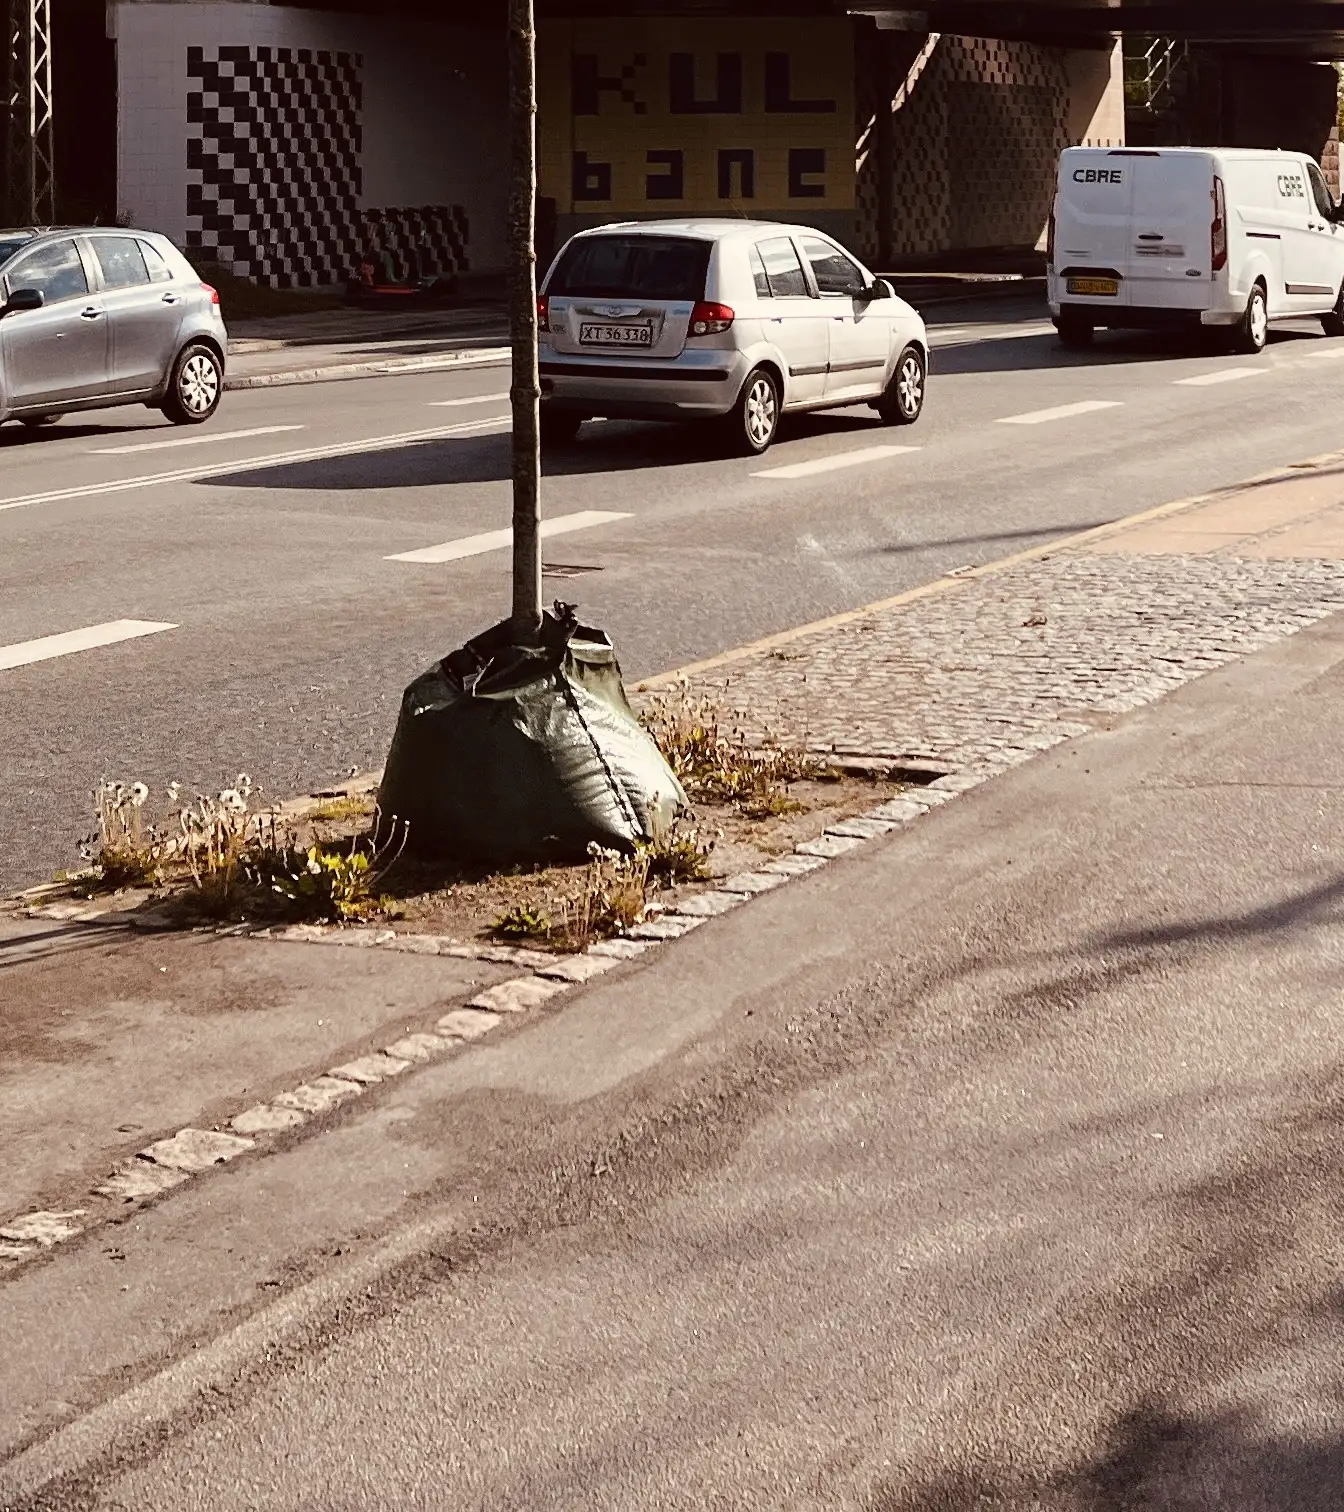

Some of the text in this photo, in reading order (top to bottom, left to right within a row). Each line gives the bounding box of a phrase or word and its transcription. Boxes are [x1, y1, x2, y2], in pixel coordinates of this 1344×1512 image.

[573, 52, 837, 115] KUL
[573, 148, 826, 201] bane
[1072, 169, 1122, 184] CBRE
